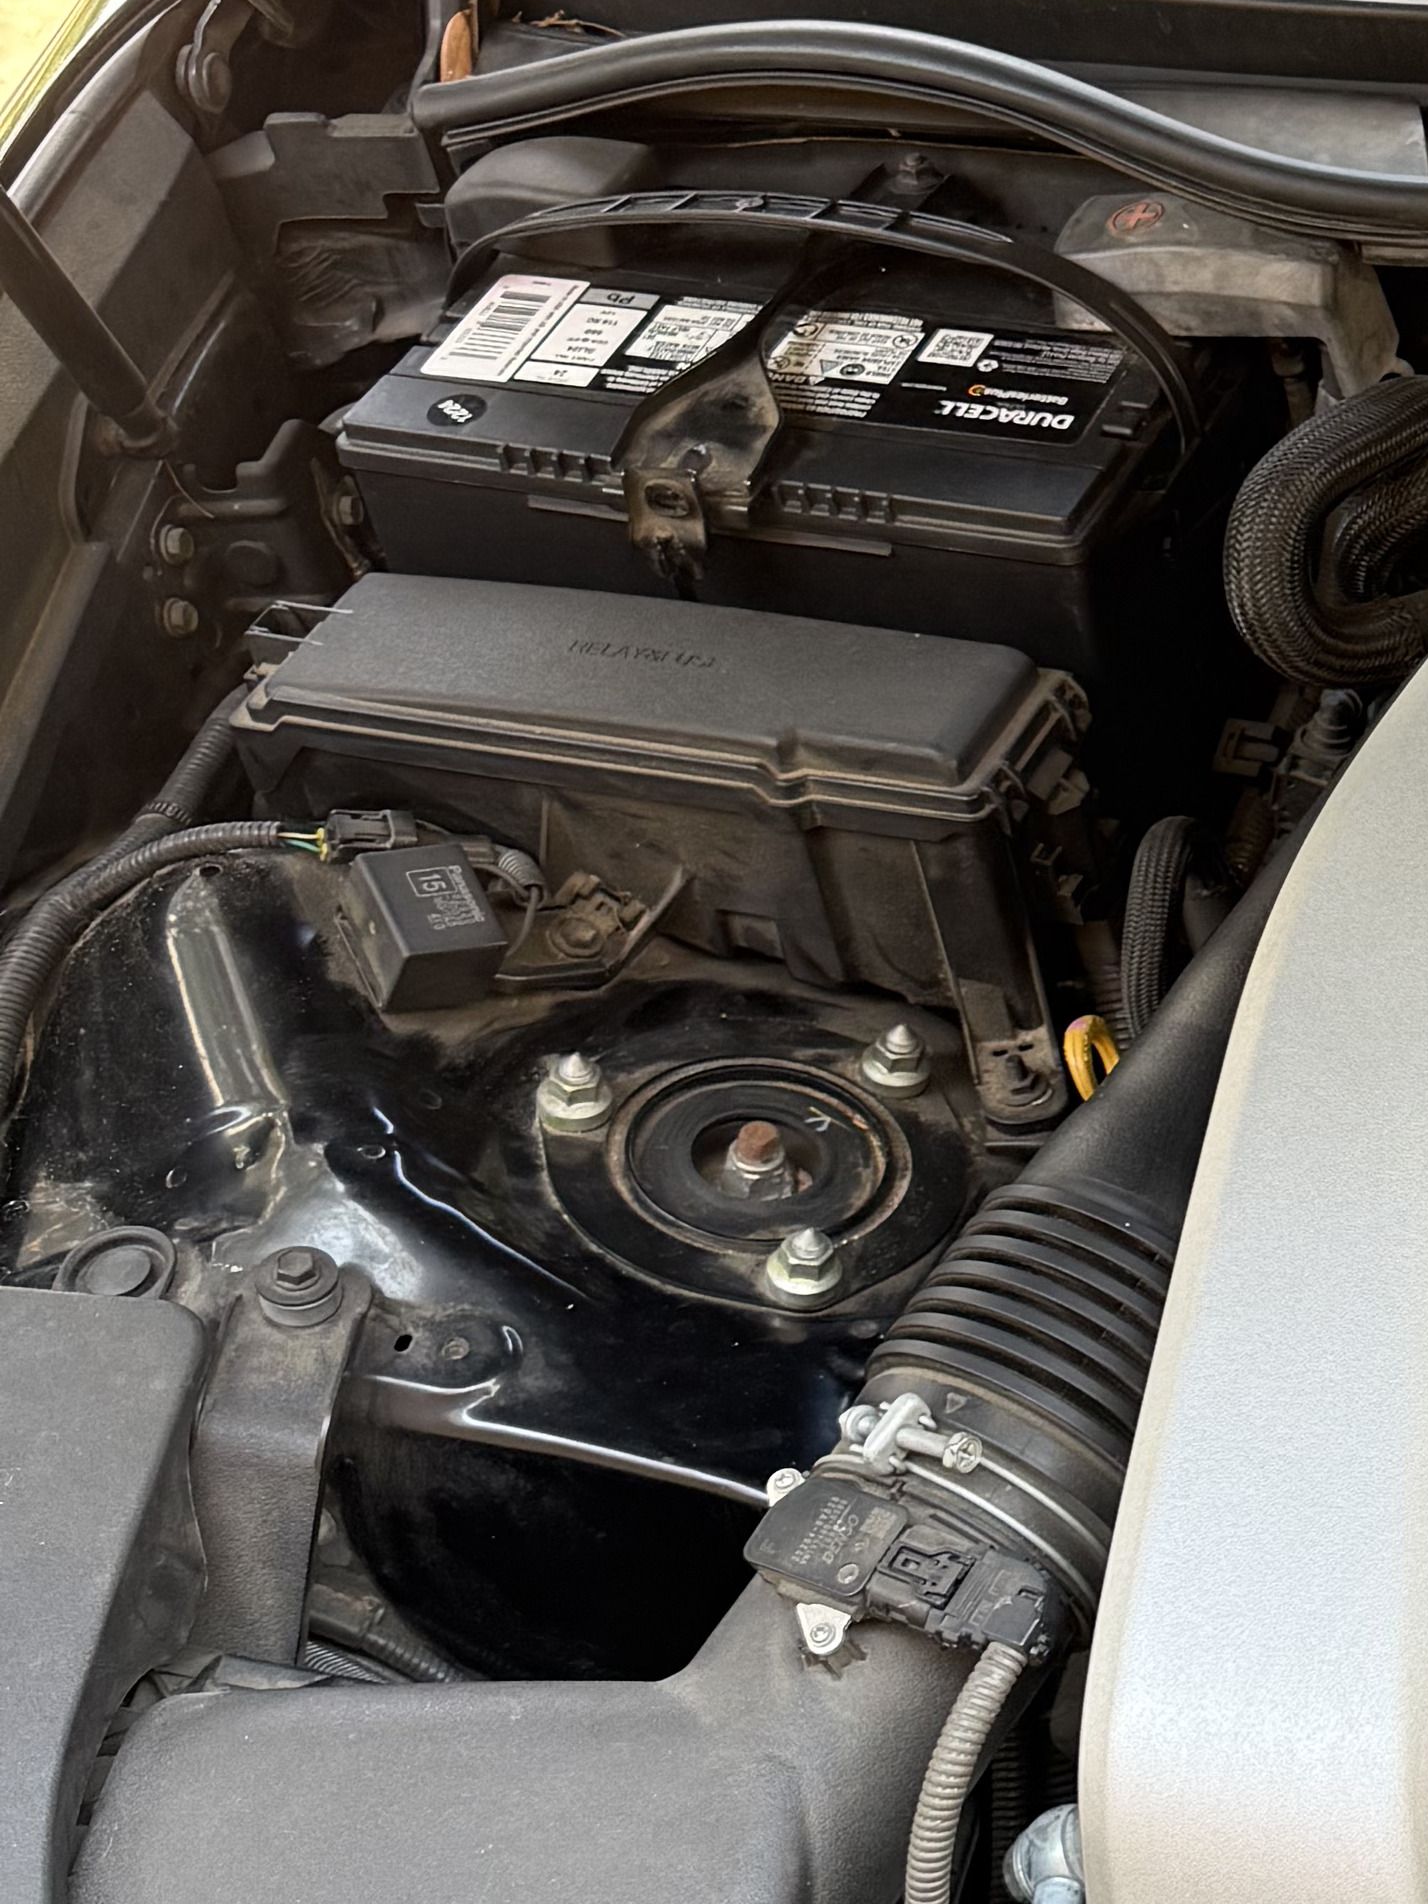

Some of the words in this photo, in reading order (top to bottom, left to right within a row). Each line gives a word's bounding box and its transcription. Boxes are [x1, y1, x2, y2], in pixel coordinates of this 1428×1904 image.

[939, 399, 1075, 430] DURACELL
[418, 874, 447, 892] 15
[449, 865, 486, 922] Panasonic
[821, 1514, 859, 1565] DENSO
